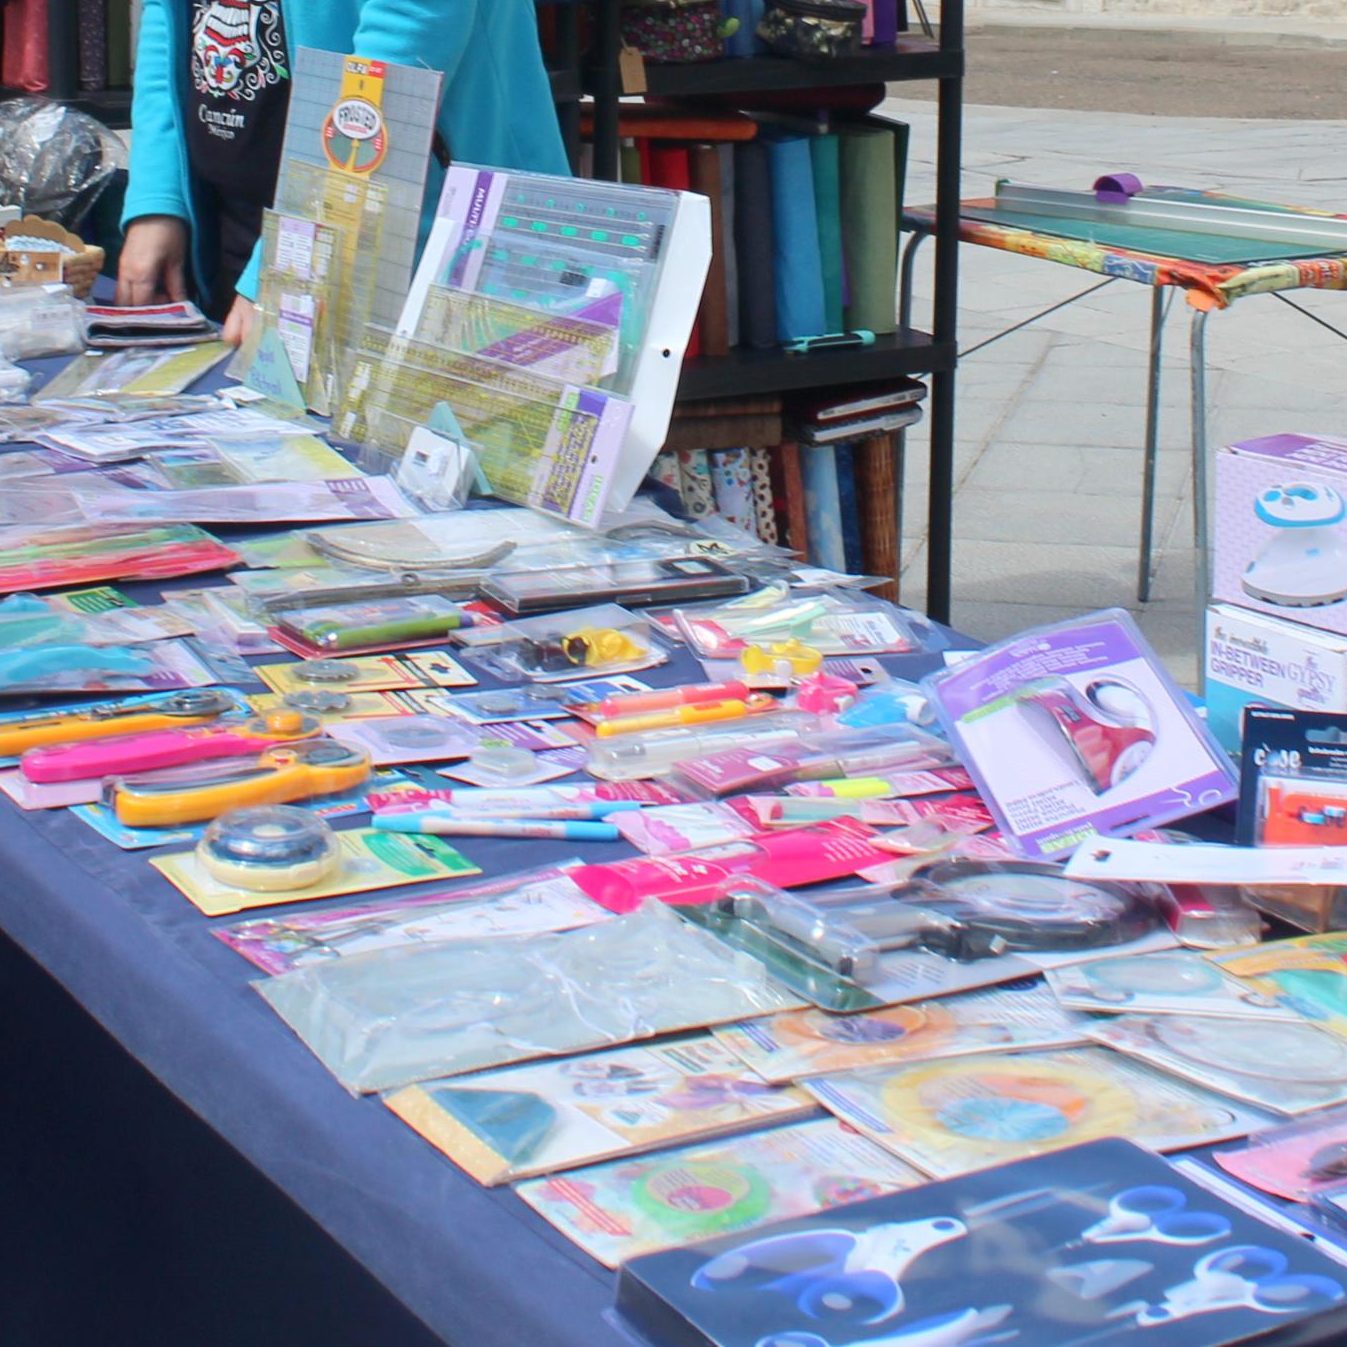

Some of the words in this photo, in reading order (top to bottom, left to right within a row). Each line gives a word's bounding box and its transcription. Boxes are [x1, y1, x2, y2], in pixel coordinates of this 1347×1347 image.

[198, 103, 245, 129] Cancún
[1211, 640, 1286, 680] IN-BETWEEN
[1211, 657, 1264, 688] GRIPPER
[1287, 662, 1336, 694] GYPSY
